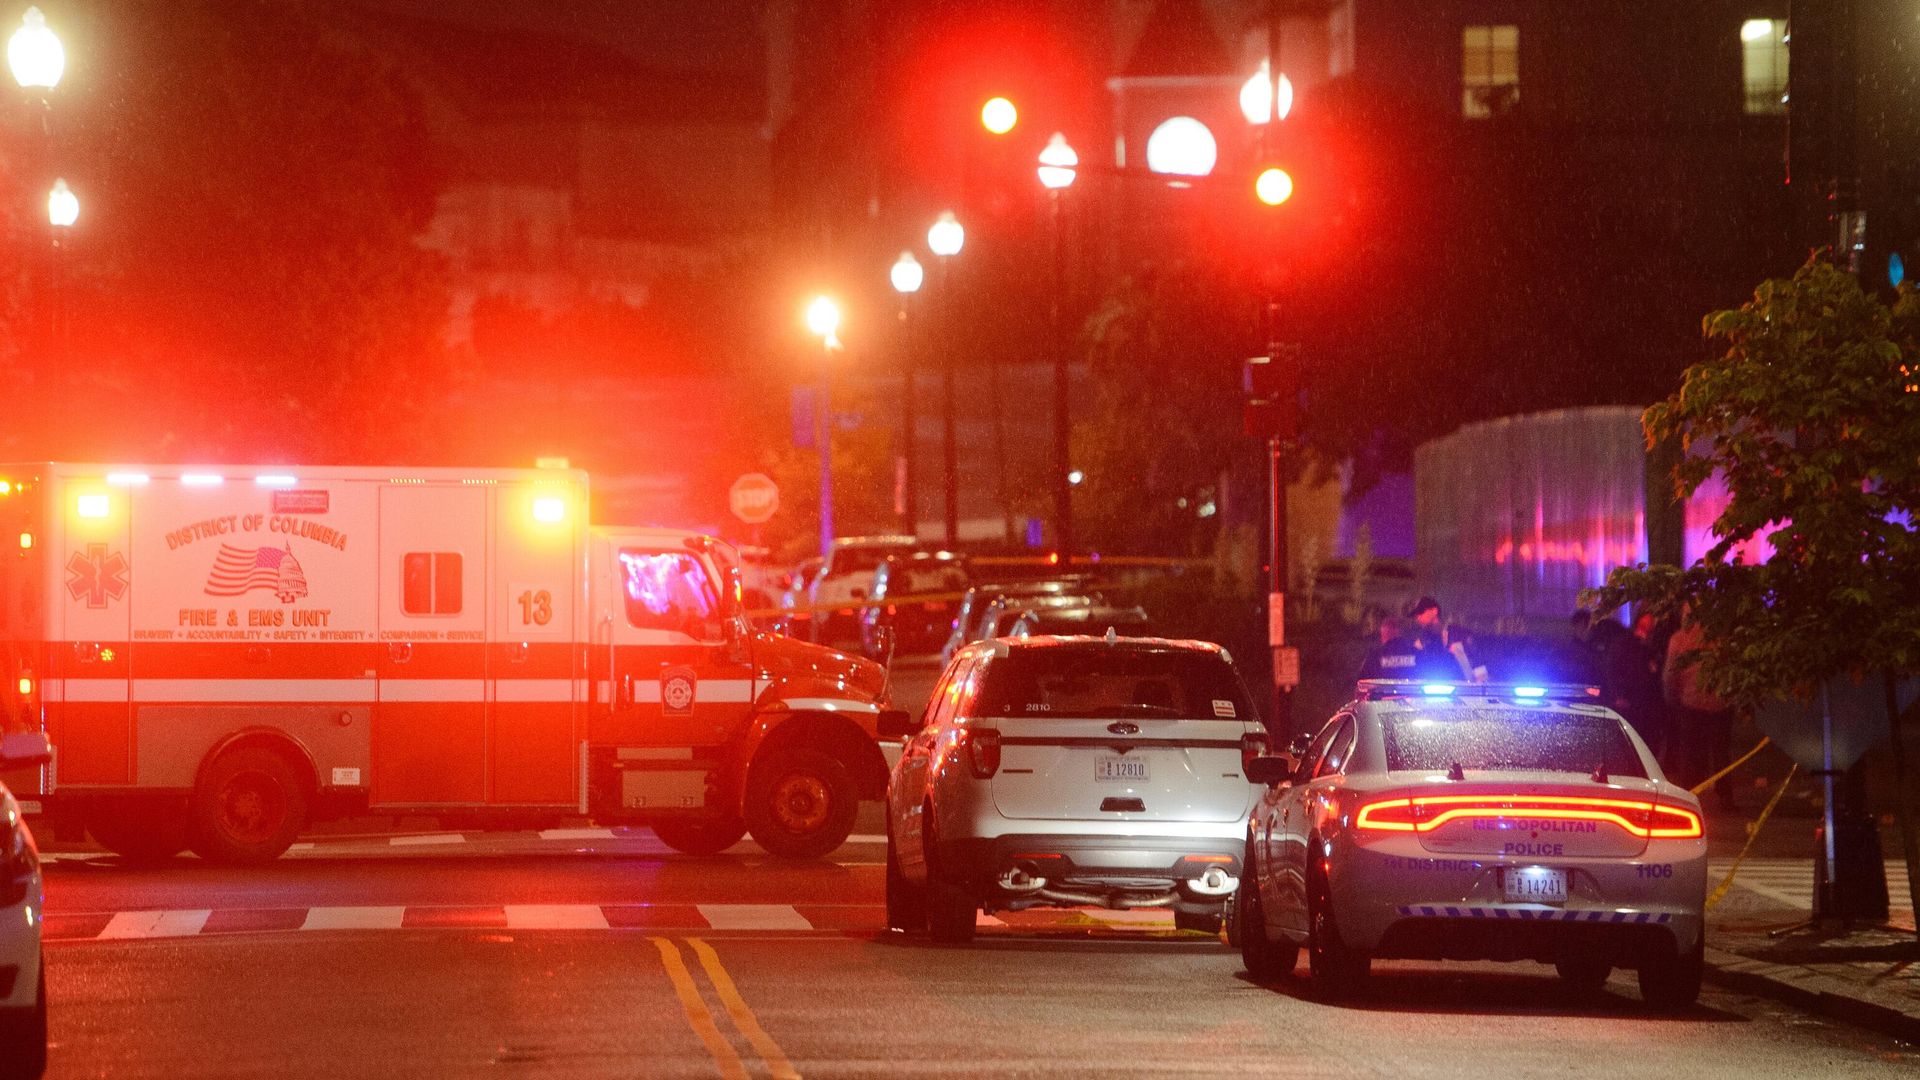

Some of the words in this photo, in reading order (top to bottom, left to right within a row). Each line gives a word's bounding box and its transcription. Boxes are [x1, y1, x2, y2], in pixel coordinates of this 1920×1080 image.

[165, 514, 237, 551] DISTRICT
[241, 514, 264, 532] OF
[269, 515, 348, 552] COLUMBIA
[518, 590, 553, 625] 13
[179, 609, 217, 627] FIRE
[226, 609, 239, 627] &
[248, 609, 285, 627] EMS
[292, 609, 332, 627] UNIT
[133, 630, 175, 640] BRAVERY
[186, 630, 262, 640] ACCOUNTABILITY
[273, 630, 308, 640] SAFETY
[319, 630, 365, 641] INTEGRITY
[446, 630, 484, 641] SERVICE
[1026, 702, 1051, 712] 2810
[1116, 763, 1145, 776] 12810
[1472, 818, 1597, 833] MEOPOLITAN
[1504, 843, 1563, 856] POLICE
[1636, 863, 1673, 878] 1106
[1527, 879, 1561, 894] 14241
